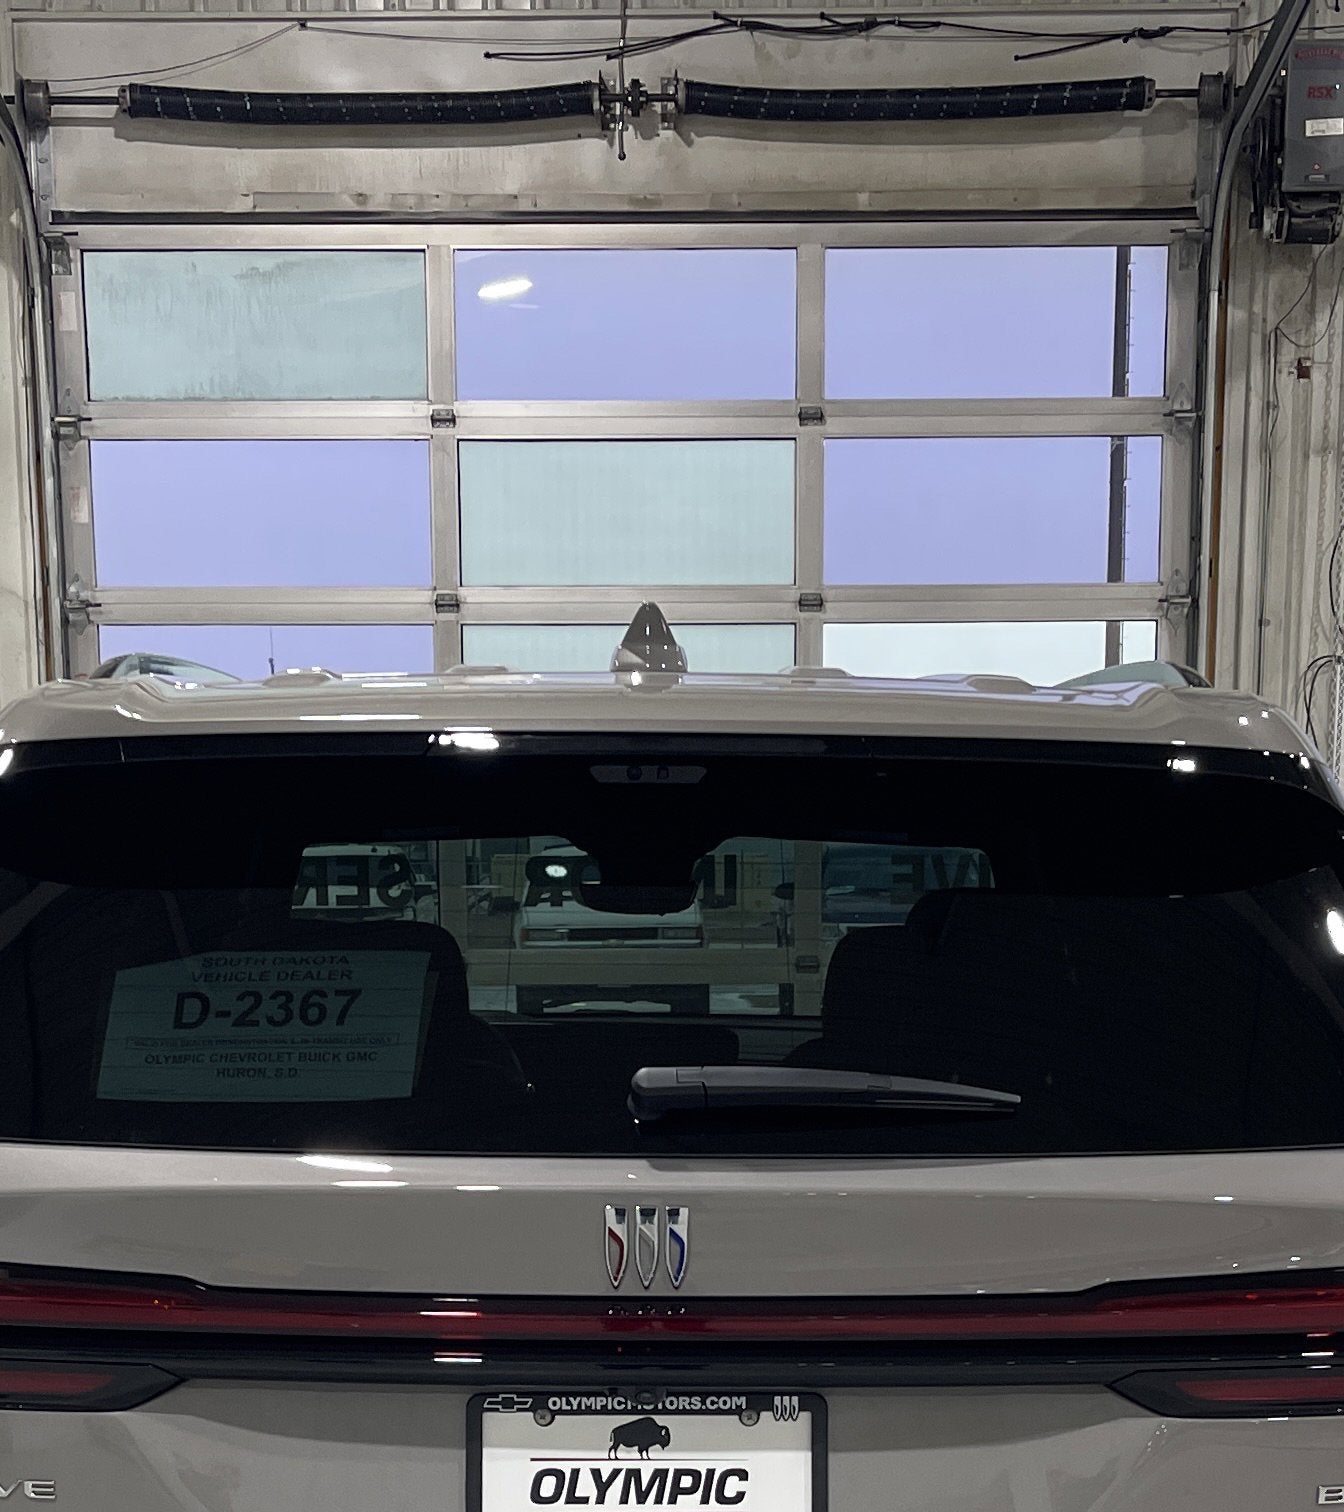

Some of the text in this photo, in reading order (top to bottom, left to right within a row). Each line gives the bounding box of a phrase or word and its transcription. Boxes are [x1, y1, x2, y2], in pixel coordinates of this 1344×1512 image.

[201, 955, 350, 968] SOUTH DAKOTA
[191, 969, 353, 983] VEHICLE DEALER
[173, 988, 363, 1030] D-2367
[144, 1051, 378, 1065] OLYMPIC CHEVROLET BUICK GMC
[530, 1467, 750, 1506] OLYMPIC
